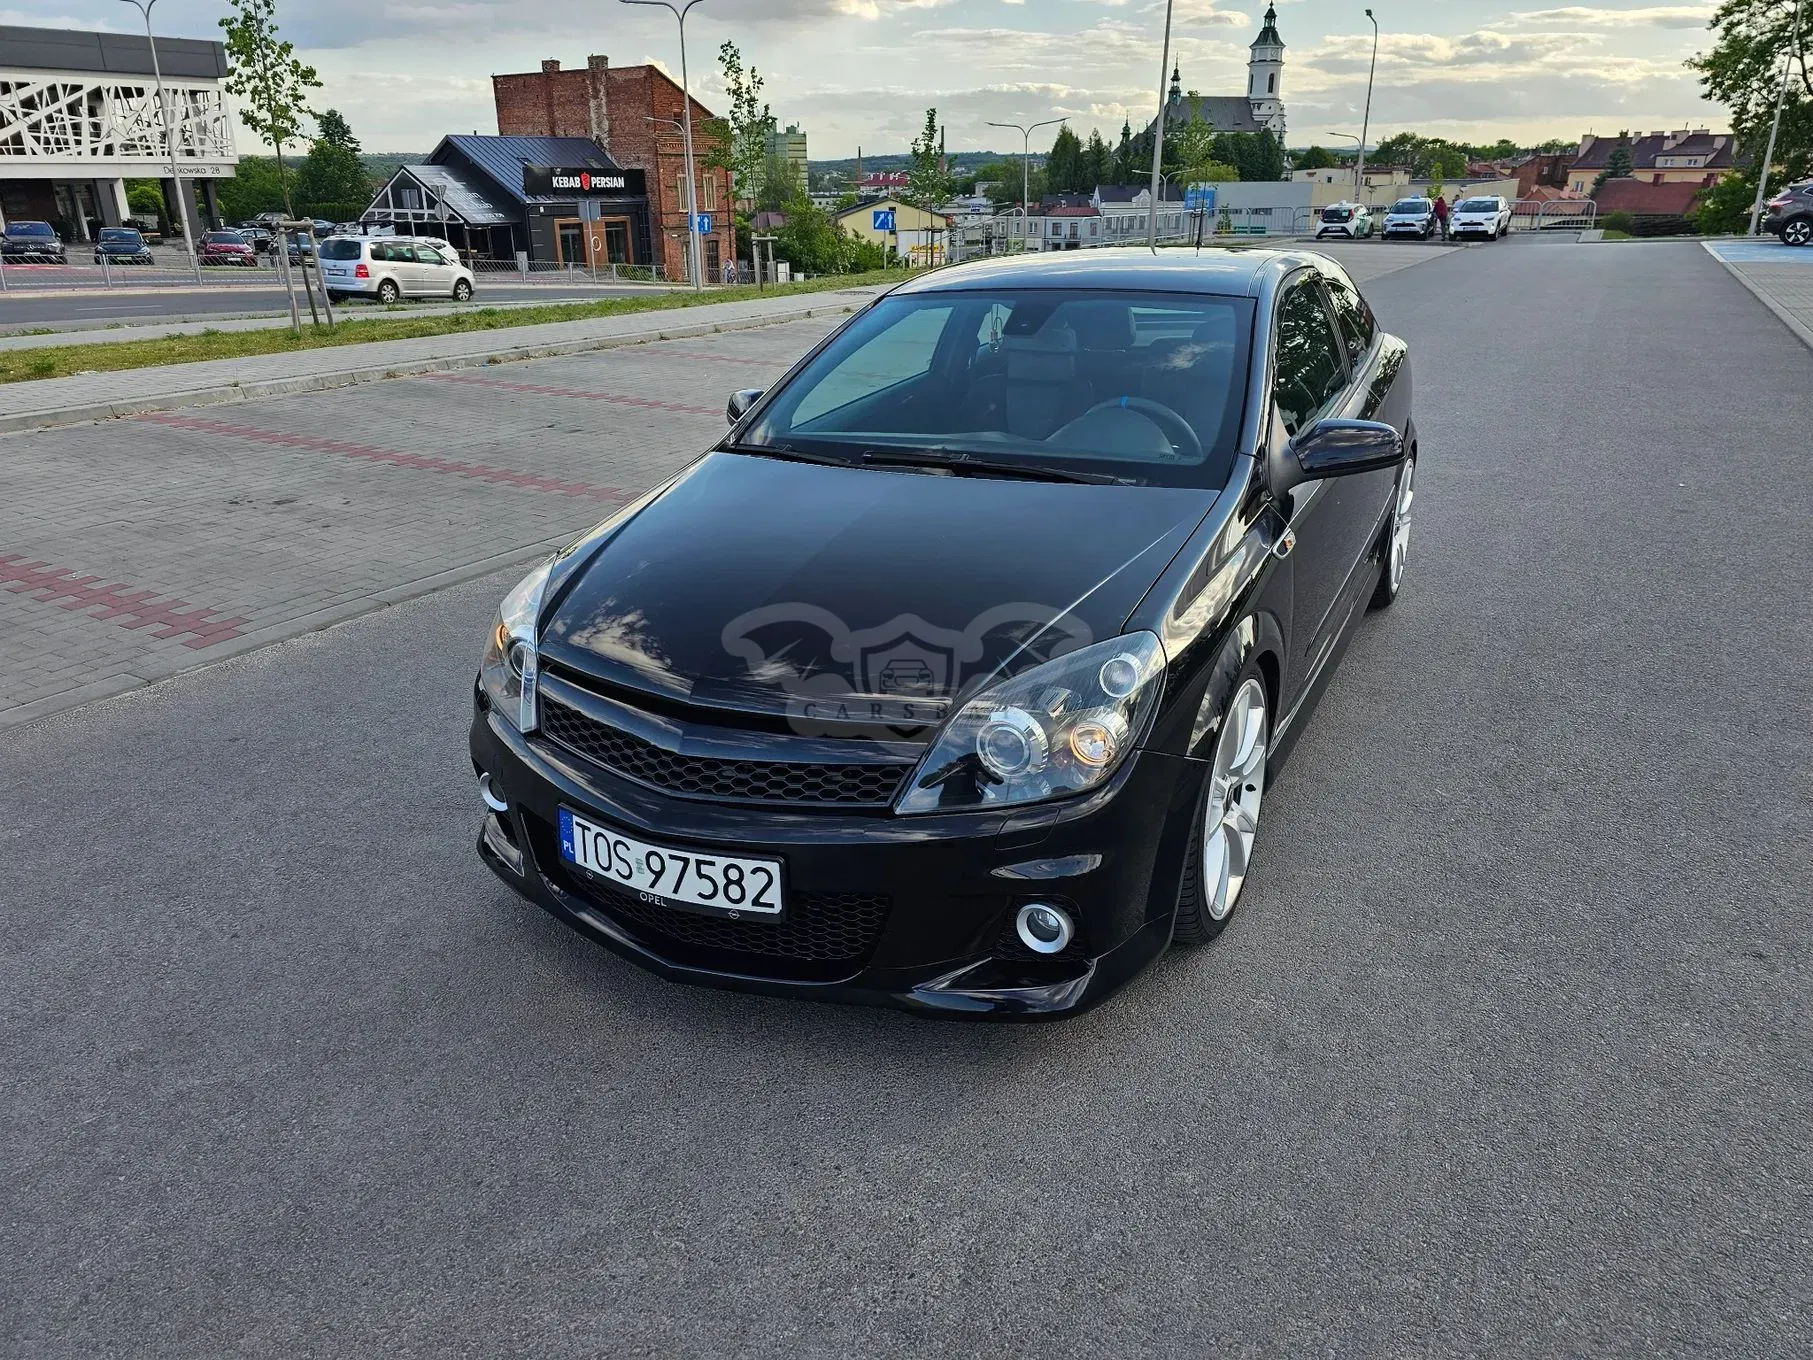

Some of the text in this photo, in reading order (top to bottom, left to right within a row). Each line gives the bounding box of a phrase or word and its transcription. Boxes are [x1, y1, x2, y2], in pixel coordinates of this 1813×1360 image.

[210, 166, 221, 175] 28
[552, 176, 625, 188] KEBAB PERSIAN
[563, 840, 574, 854] PL
[575, 821, 776, 909] TOS 97582
[640, 891, 667, 907] OPEL
